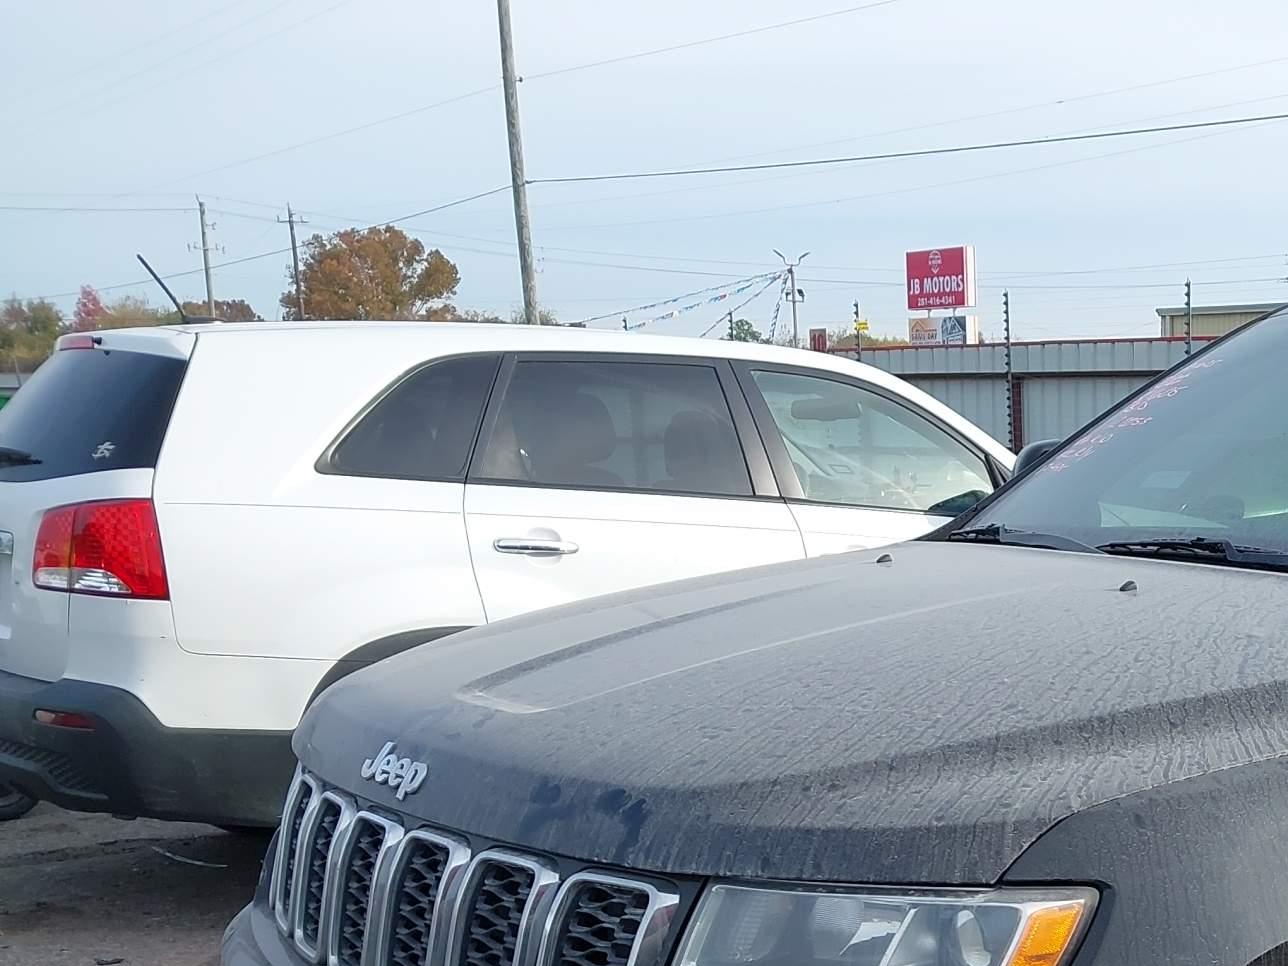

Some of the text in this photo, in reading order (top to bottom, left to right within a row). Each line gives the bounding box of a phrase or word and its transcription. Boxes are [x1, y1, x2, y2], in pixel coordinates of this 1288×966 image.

[910, 274, 963, 295] JB MOTORS
[361, 741, 428, 800] Jeep
